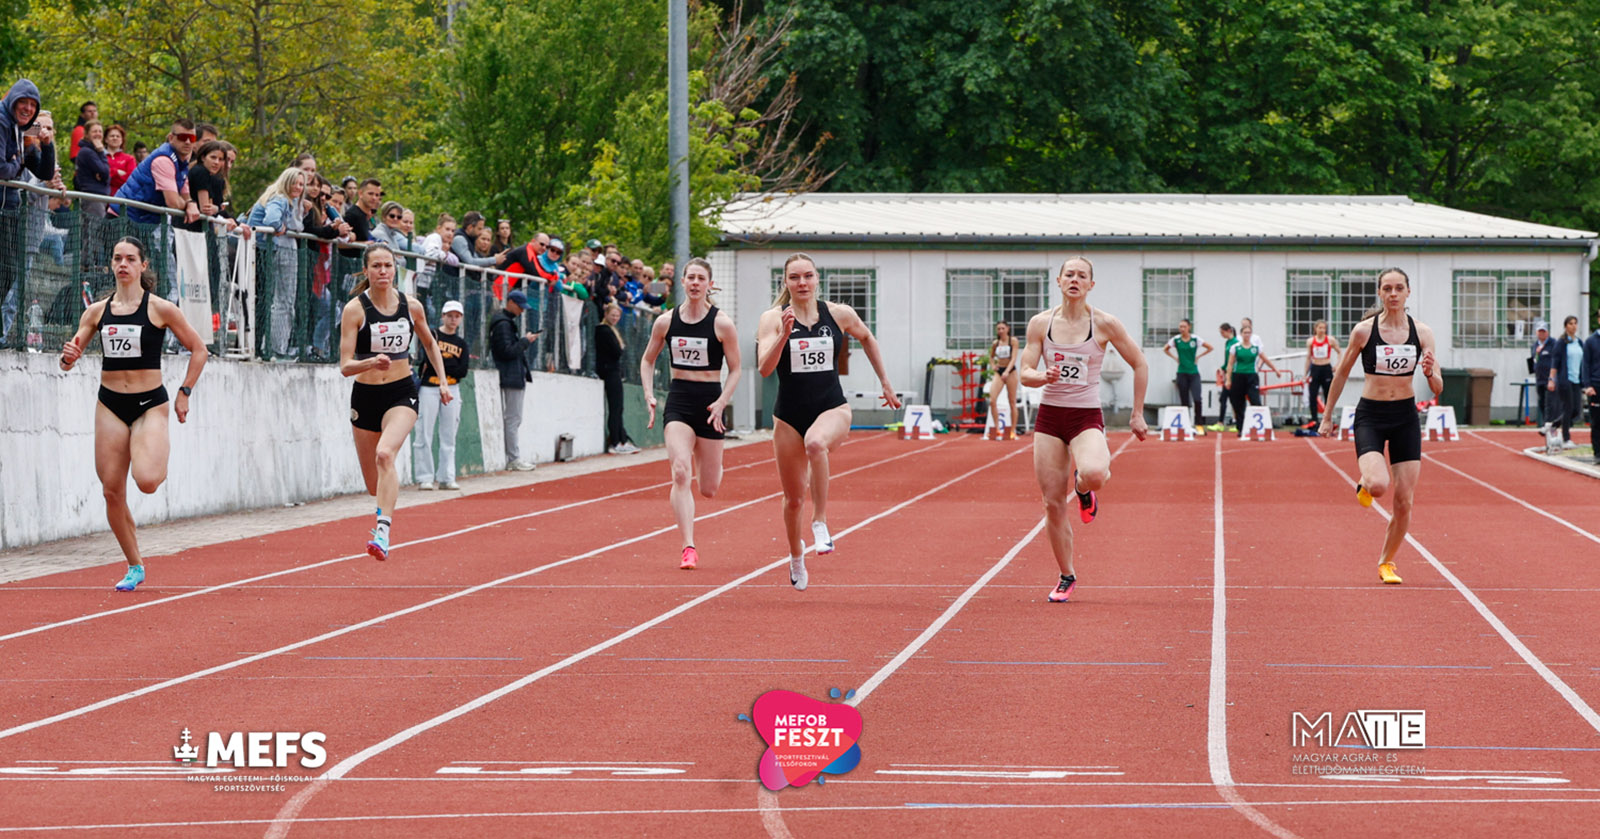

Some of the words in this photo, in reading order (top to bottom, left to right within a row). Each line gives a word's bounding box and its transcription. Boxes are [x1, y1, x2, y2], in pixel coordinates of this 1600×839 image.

[109, 338, 132, 351] 176
[380, 335, 403, 348] 173
[679, 349, 701, 361] 172
[800, 351, 826, 366] 158
[1384, 357, 1409, 370] 162
[1059, 365, 1080, 379] 52
[911, 411, 924, 427] 7
[1170, 413, 1183, 429] 4
[1252, 412, 1264, 431] 3
[1437, 413, 1446, 428] 1
